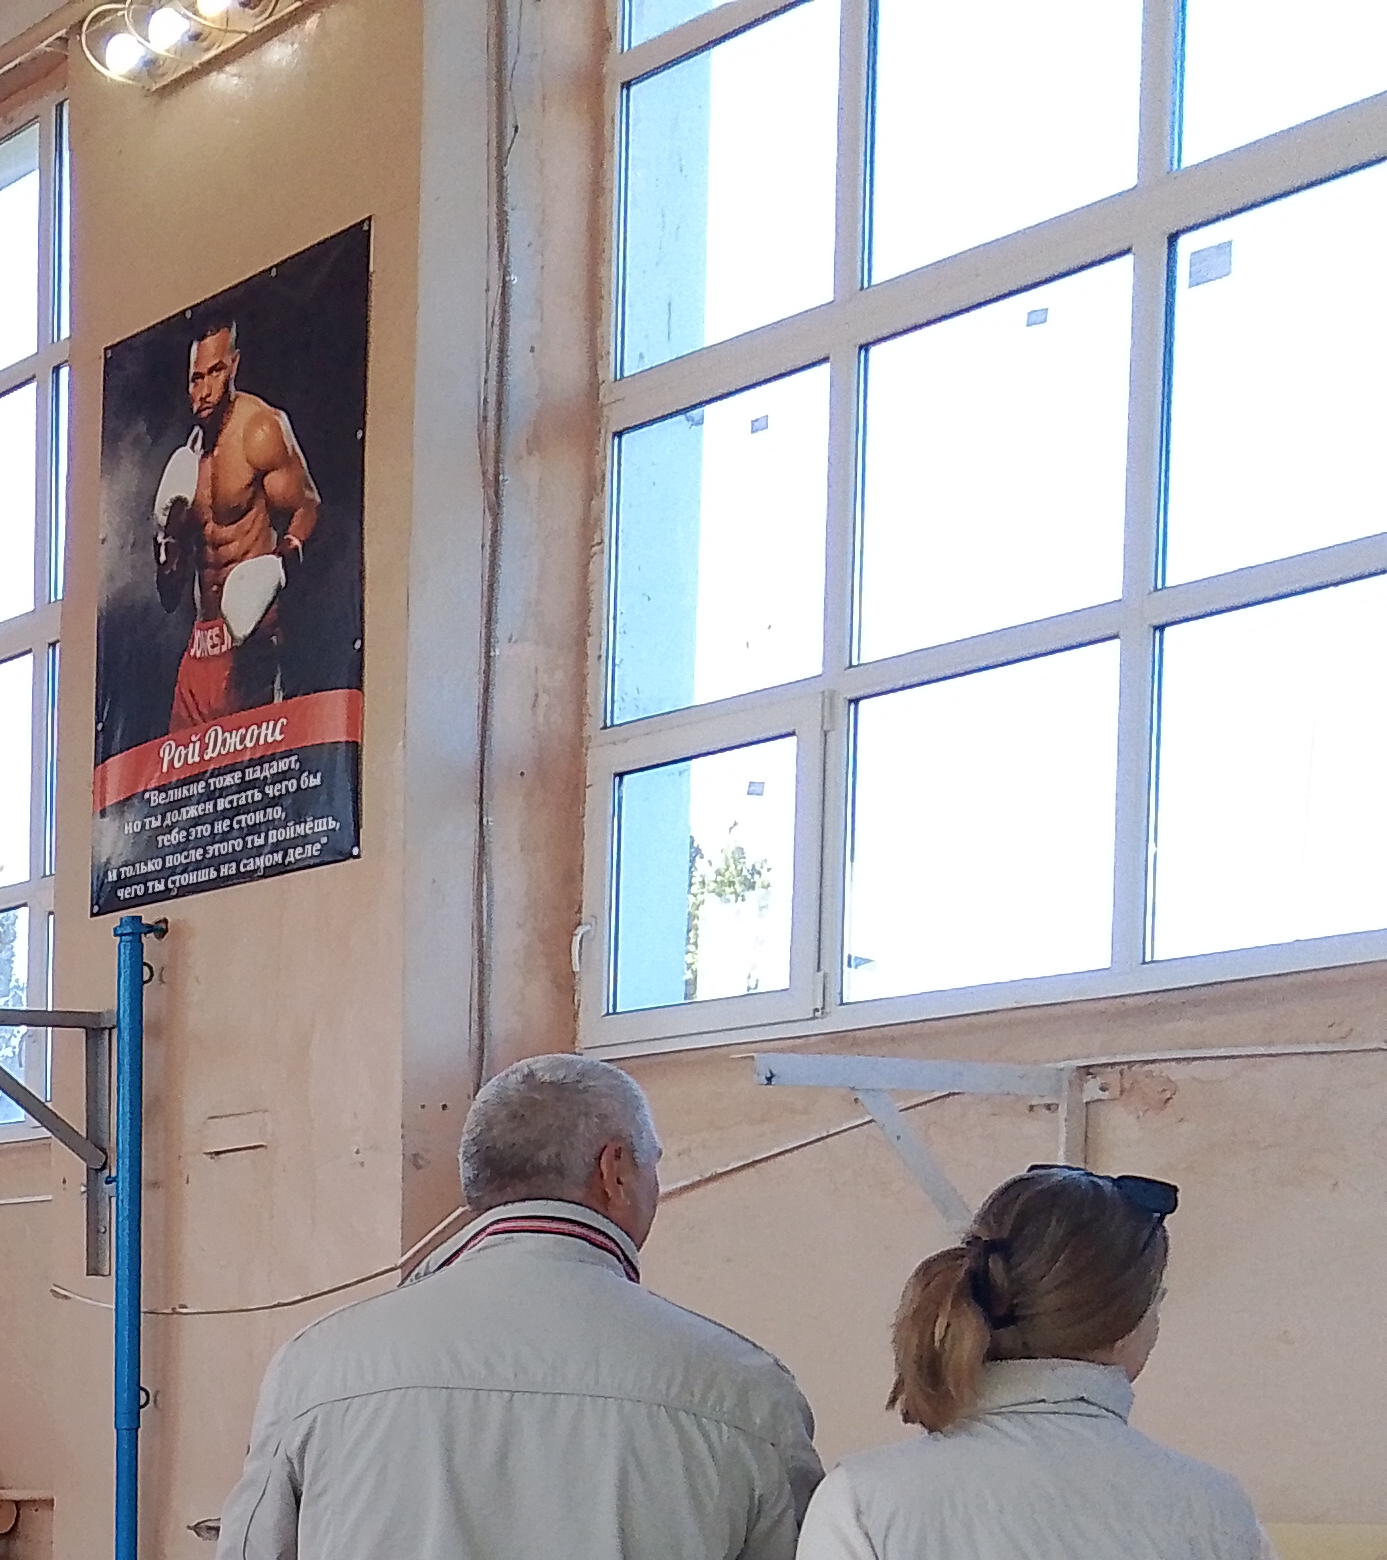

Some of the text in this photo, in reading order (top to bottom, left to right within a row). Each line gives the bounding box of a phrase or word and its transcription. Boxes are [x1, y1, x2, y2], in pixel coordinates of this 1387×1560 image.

[159, 718, 288, 773] Рой Джонс
[208, 770, 243, 790] тоже
[245, 754, 300, 780] падают,
[124, 771, 322, 835] но ты должен встать чего бы
[157, 805, 287, 848] тебе это не стоило,
[107, 814, 341, 883] и только после этого ты поймёшь,
[116, 883, 145, 901] чего
[147, 877, 166, 894] ты
[167, 866, 218, 889] стоишь
[219, 862, 237, 878] на
[239, 850, 284, 873] самом
